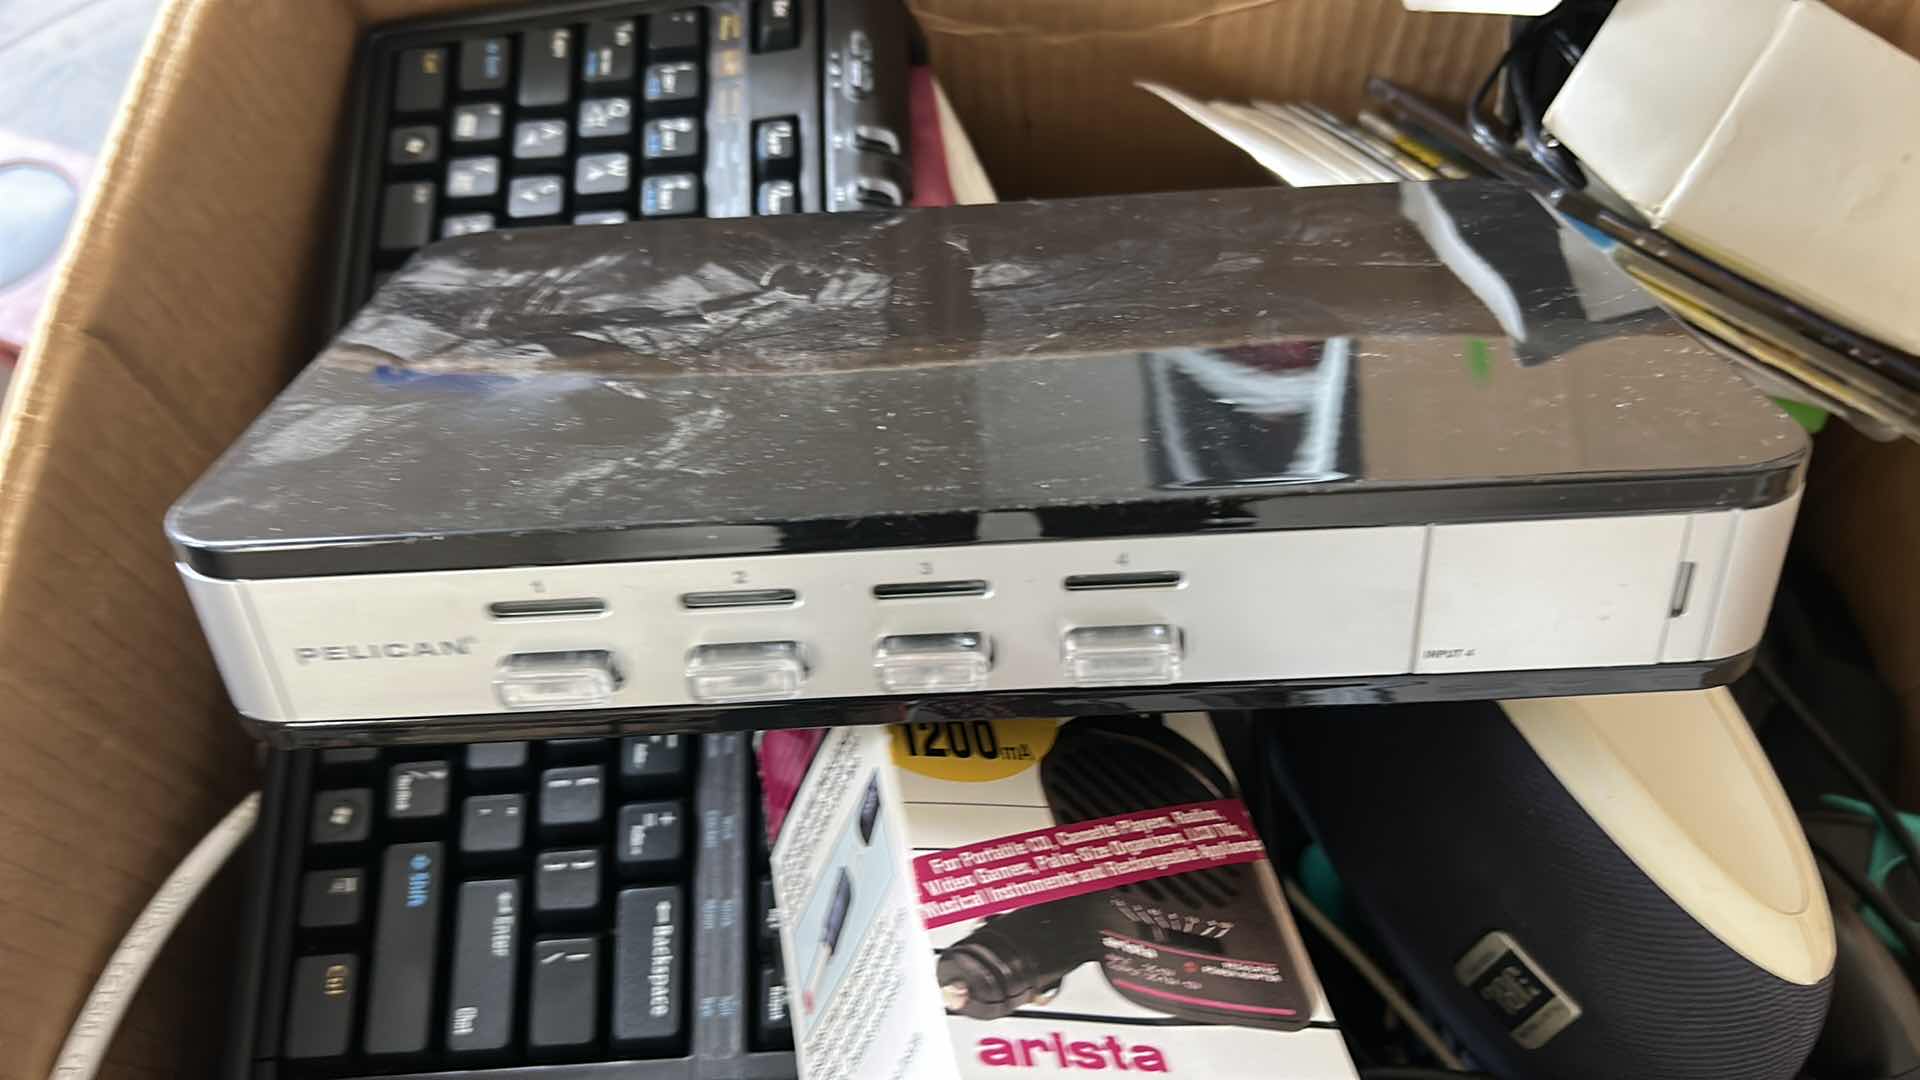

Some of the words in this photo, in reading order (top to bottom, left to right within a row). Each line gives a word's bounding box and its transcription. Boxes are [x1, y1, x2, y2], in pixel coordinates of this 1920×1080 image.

[919, 562, 934, 576] 3
[1115, 553, 1131, 567] 4
[733, 570, 748, 584] 2
[294, 640, 471, 665] PELICAN
[1423, 648, 1464, 659] INPUT
[903, 721, 999, 759] 1200
[928, 857, 961, 874] For
[405, 871, 431, 908] Shift
[491, 915, 516, 957] Enter
[648, 925, 674, 1017] Backspace
[978, 1032, 1169, 1073] arista
